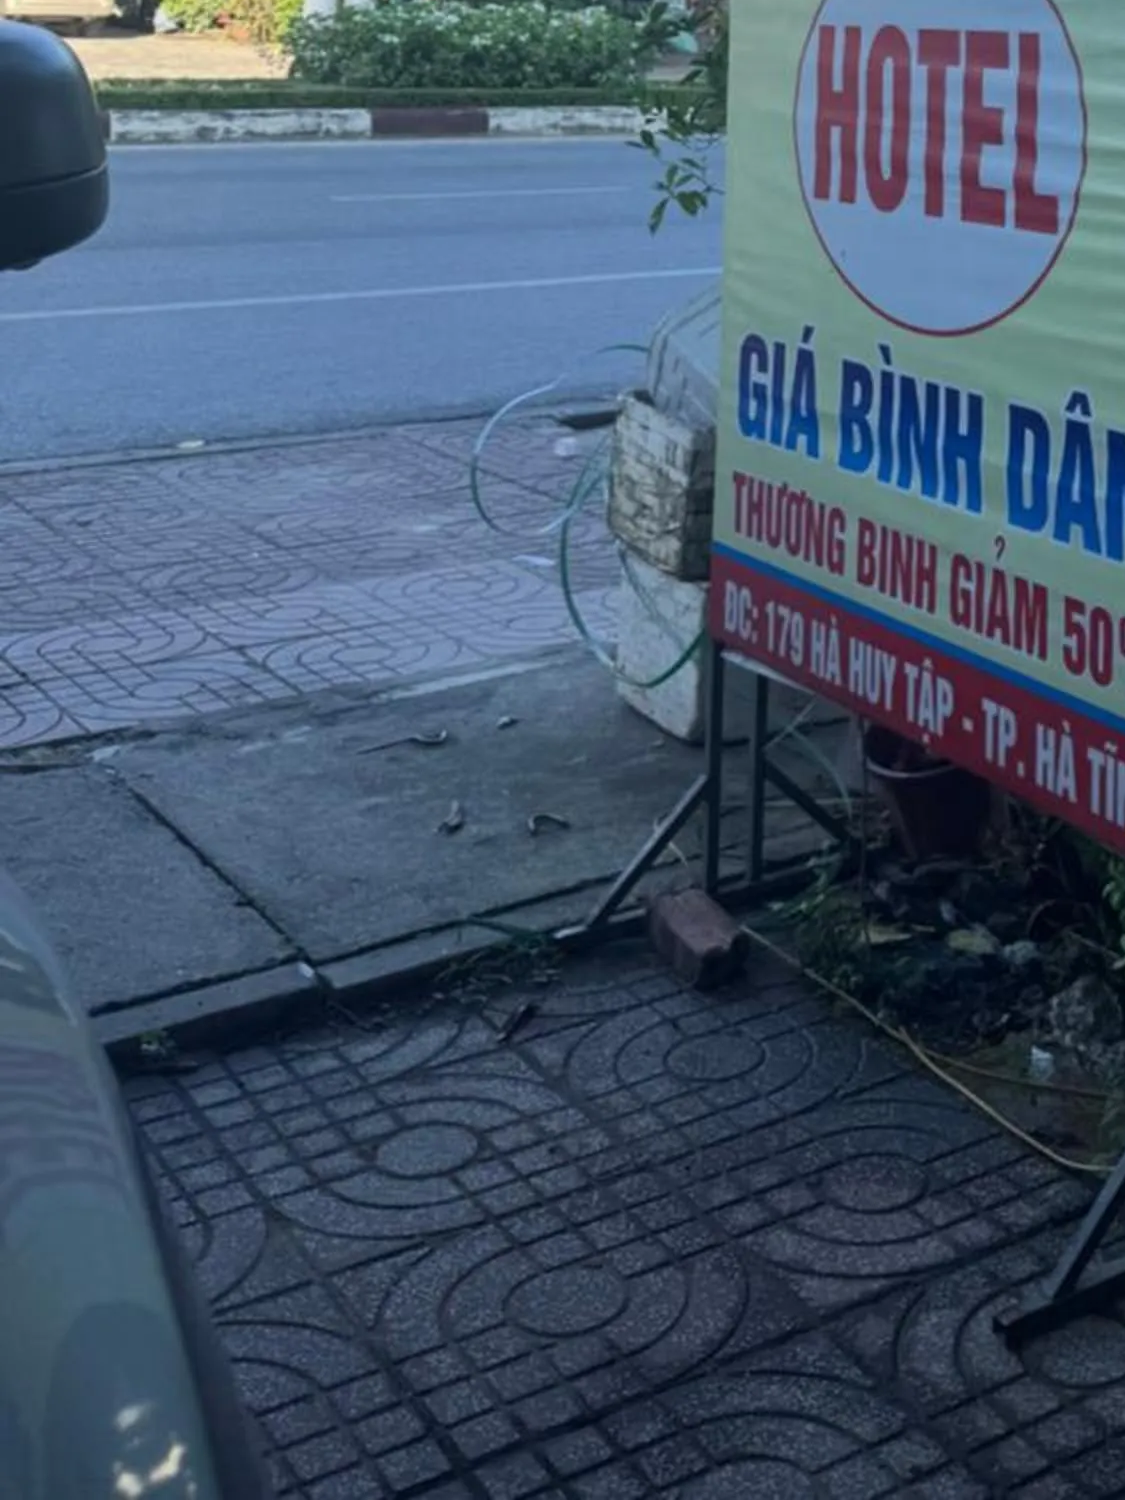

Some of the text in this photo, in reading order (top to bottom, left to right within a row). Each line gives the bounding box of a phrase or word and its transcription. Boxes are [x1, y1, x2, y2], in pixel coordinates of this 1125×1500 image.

[813, 24, 1059, 235] HOTEL
[737, 326, 820, 460] GIÁ
[837, 343, 985, 514] BÌNH
[732, 471, 846, 576] THƯƠNG
[856, 517, 938, 614] BINH
[949, 535, 1049, 662] GIẢM
[724, 579, 759, 644] ĐC:
[765, 600, 805, 667] 179
[810, 613, 842, 687] HÀ
[849, 636, 897, 712] HUY
[904, 657, 955, 746] TẬP
[1035, 719, 1078, 804] HÀ
